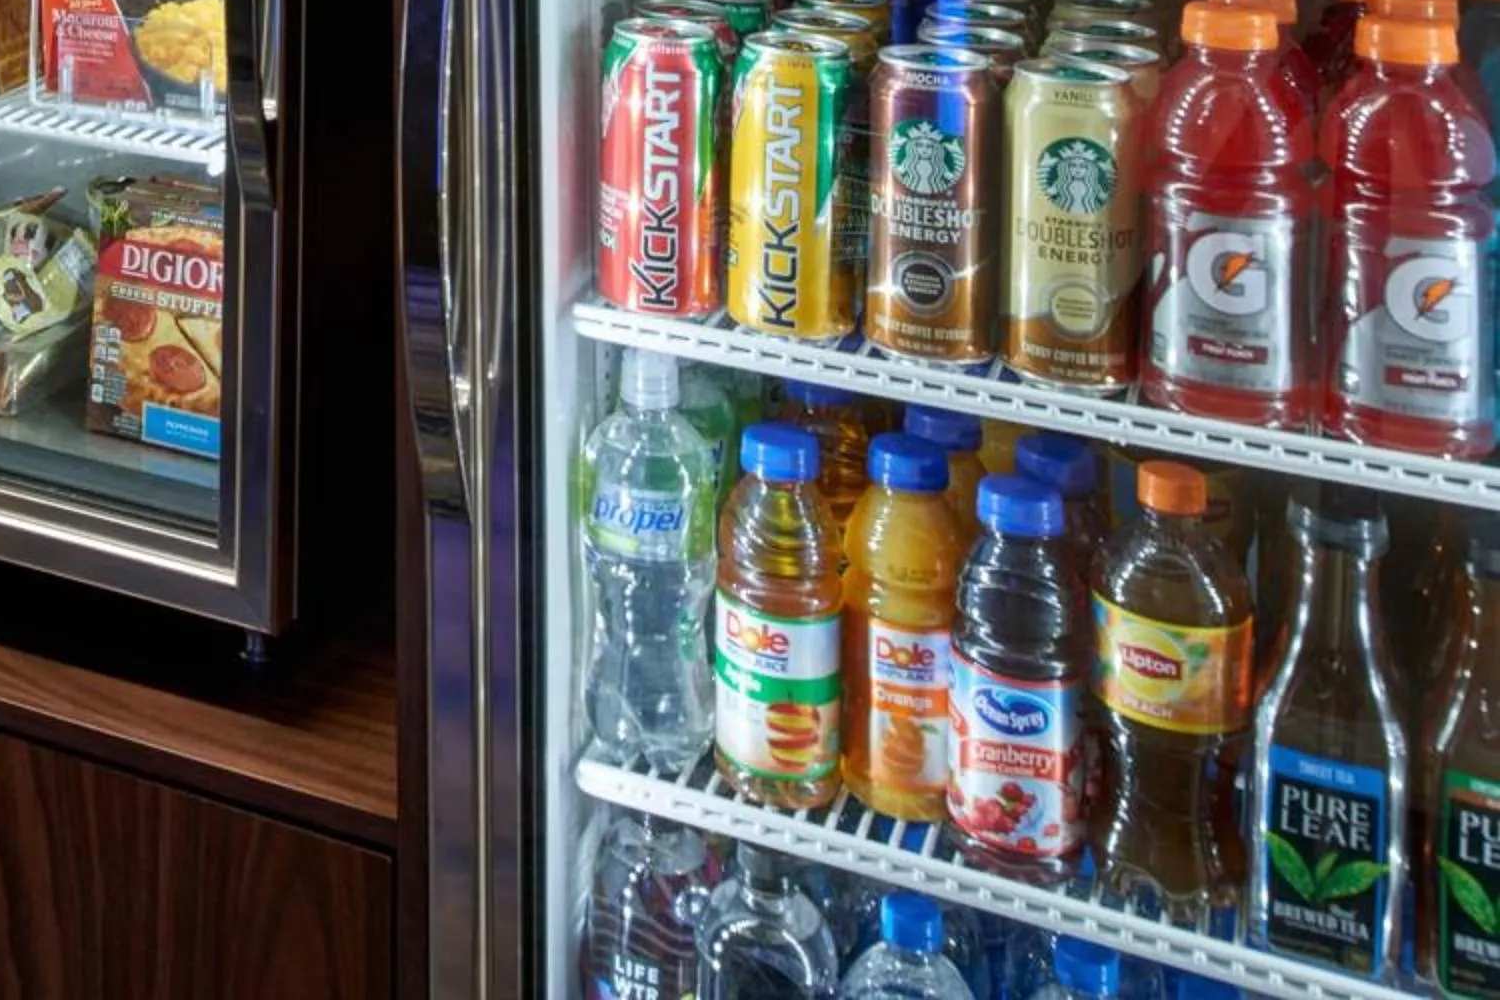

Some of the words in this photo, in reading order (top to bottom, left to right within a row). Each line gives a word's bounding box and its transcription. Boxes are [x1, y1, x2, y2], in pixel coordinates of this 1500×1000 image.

[906, 72, 950, 87] MOCHA
[631, 63, 682, 307] KICKSTART
[757, 76, 806, 329] KICKSTART
[870, 194, 987, 230] DOUBLESHO
[888, 224, 962, 245] ENERGY
[121, 245, 225, 293] DIGIOR
[1186, 231, 1267, 316] G
[157, 290, 223, 319] STUFF
[1385, 255, 1472, 343] G
[594, 496, 684, 535] propel
[726, 609, 790, 655] Dole
[875, 636, 935, 667] Dole
[1121, 645, 1178, 677] Lipton
[1281, 783, 1372, 826] PURE
[1280, 808, 1372, 853] LEAF
[1459, 809, 1500, 843] PU
[1457, 833, 1500, 869] LE
[613, 953, 660, 986] LIFE
[613, 973, 660, 1000] WTR
